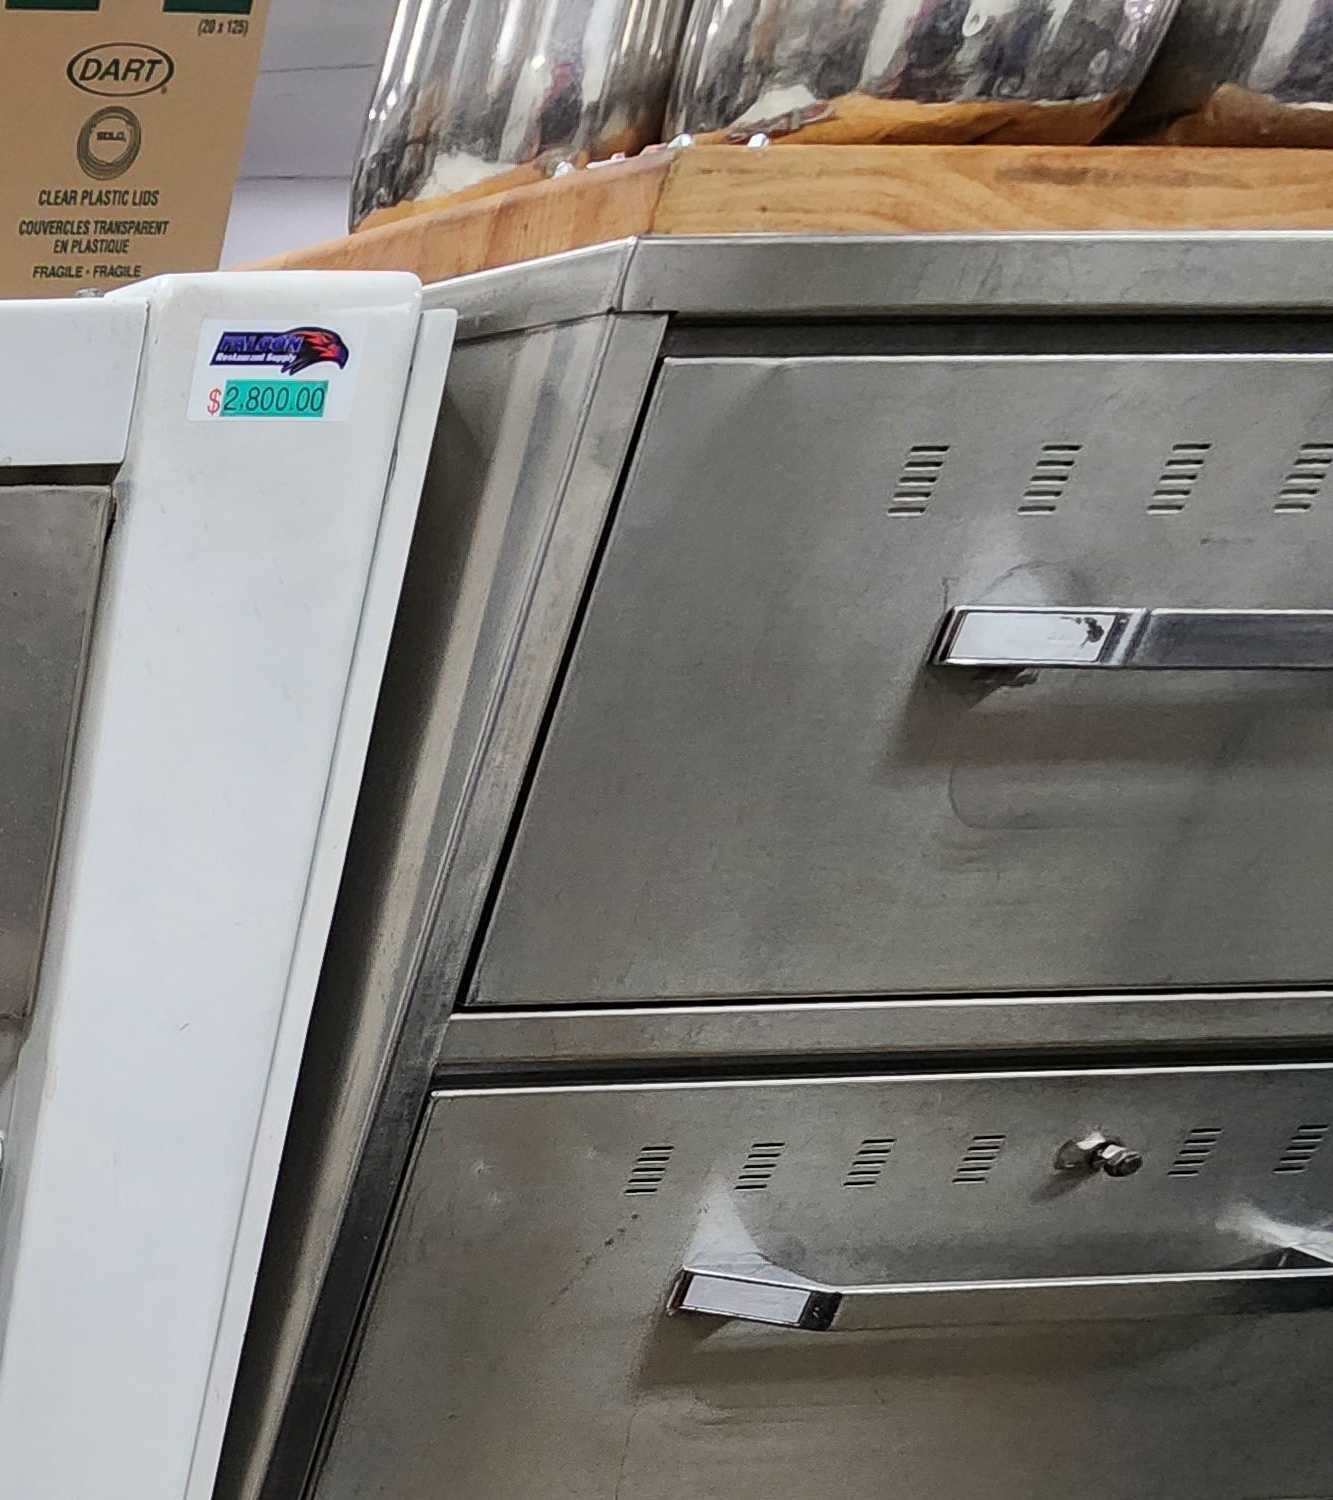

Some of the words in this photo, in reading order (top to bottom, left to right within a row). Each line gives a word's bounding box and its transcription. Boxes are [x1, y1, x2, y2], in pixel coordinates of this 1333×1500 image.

[79, 58, 162, 82] DART
[38, 190, 77, 206] CLEAR
[81, 190, 129, 206] PLASTIC
[132, 190, 159, 206] LIDS
[19, 220, 90, 235] COUVERCLES
[93, 220, 169, 235] TRANSPARENT
[53, 239, 69, 254] EN
[71, 239, 129, 254] PLASTIQUE
[33, 265, 83, 278] FRAGILE
[93, 265, 141, 278] FRAGILE
